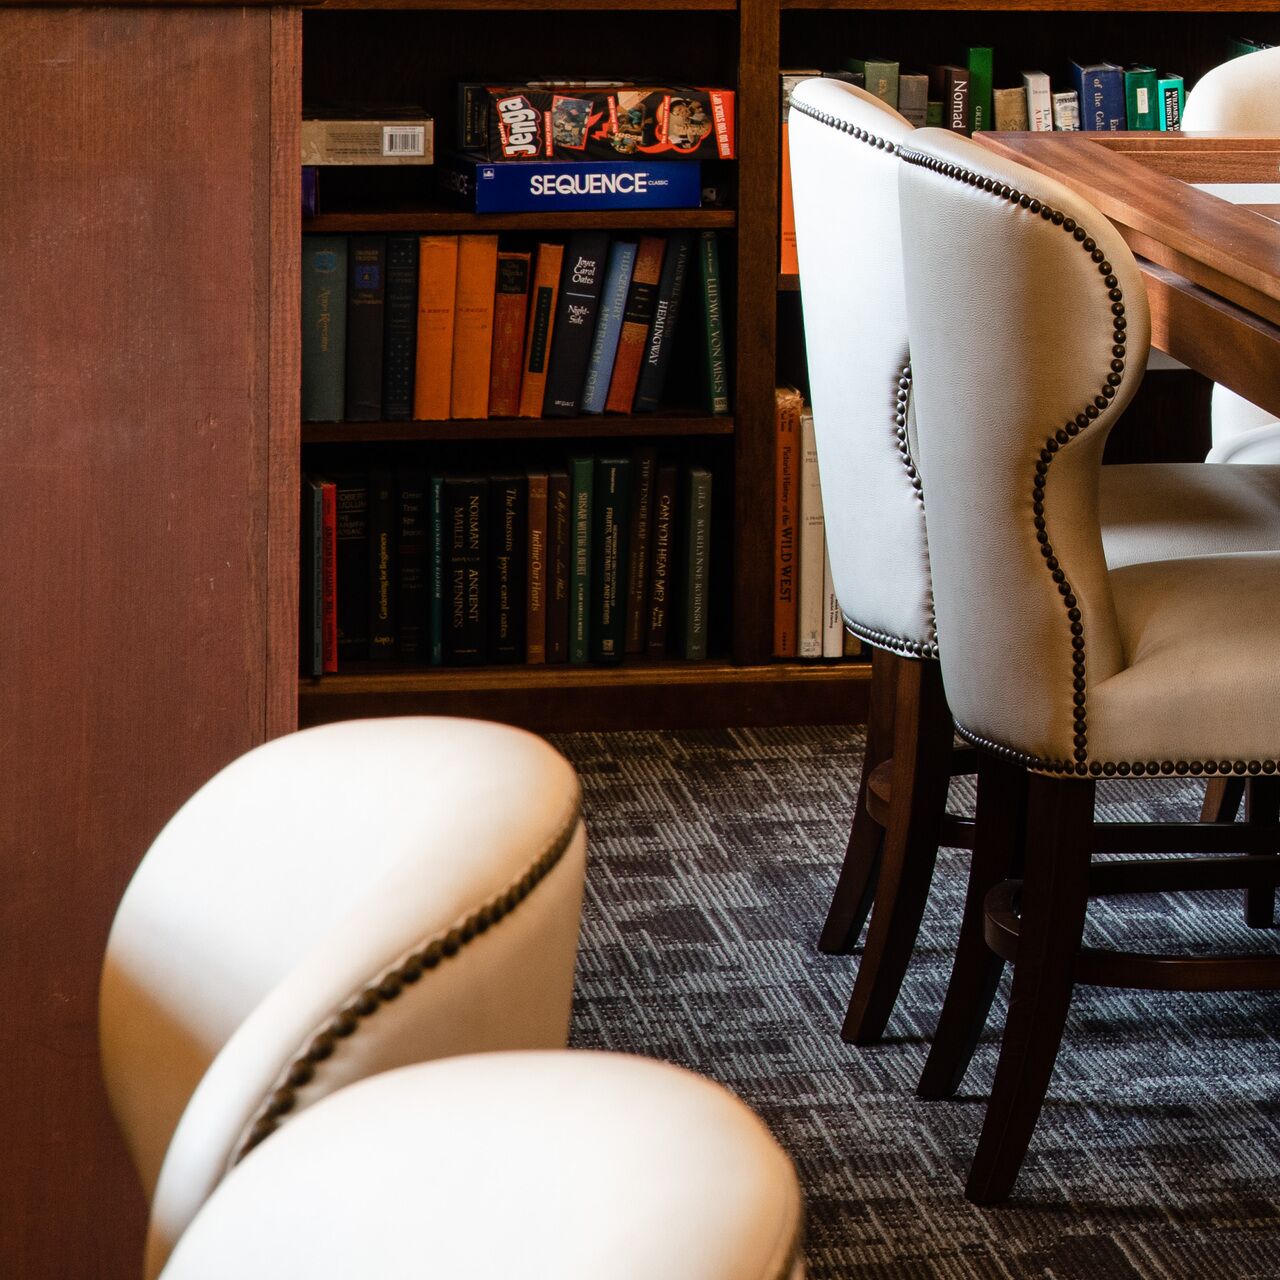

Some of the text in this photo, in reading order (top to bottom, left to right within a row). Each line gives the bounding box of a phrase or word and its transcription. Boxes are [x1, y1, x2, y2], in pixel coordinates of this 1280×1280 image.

[498, 96, 537, 155] Jenga
[952, 78, 968, 129] Nomad
[530, 172, 648, 196] SEQUENCE
[571, 273, 594, 286] Oates
[573, 265, 595, 276] Carol
[576, 255, 596, 268] Joyce
[568, 314, 584, 326] Side
[647, 298, 668, 365] HEMINGWAY
[705, 277, 724, 393] LUDWIG VON MISES
[452, 505, 465, 549] MAILER
[467, 495, 480, 550] NORMAN
[657, 494, 670, 520] CAN
[656, 522, 668, 546] YOU
[496, 487, 517, 639] The Assassins joyce carol oates
[529, 529, 542, 612] Incline Our Hearts
[451, 569, 465, 628] EVENINGS
[467, 568, 479, 621] ANCIENT
[653, 578, 665, 602] ME?
